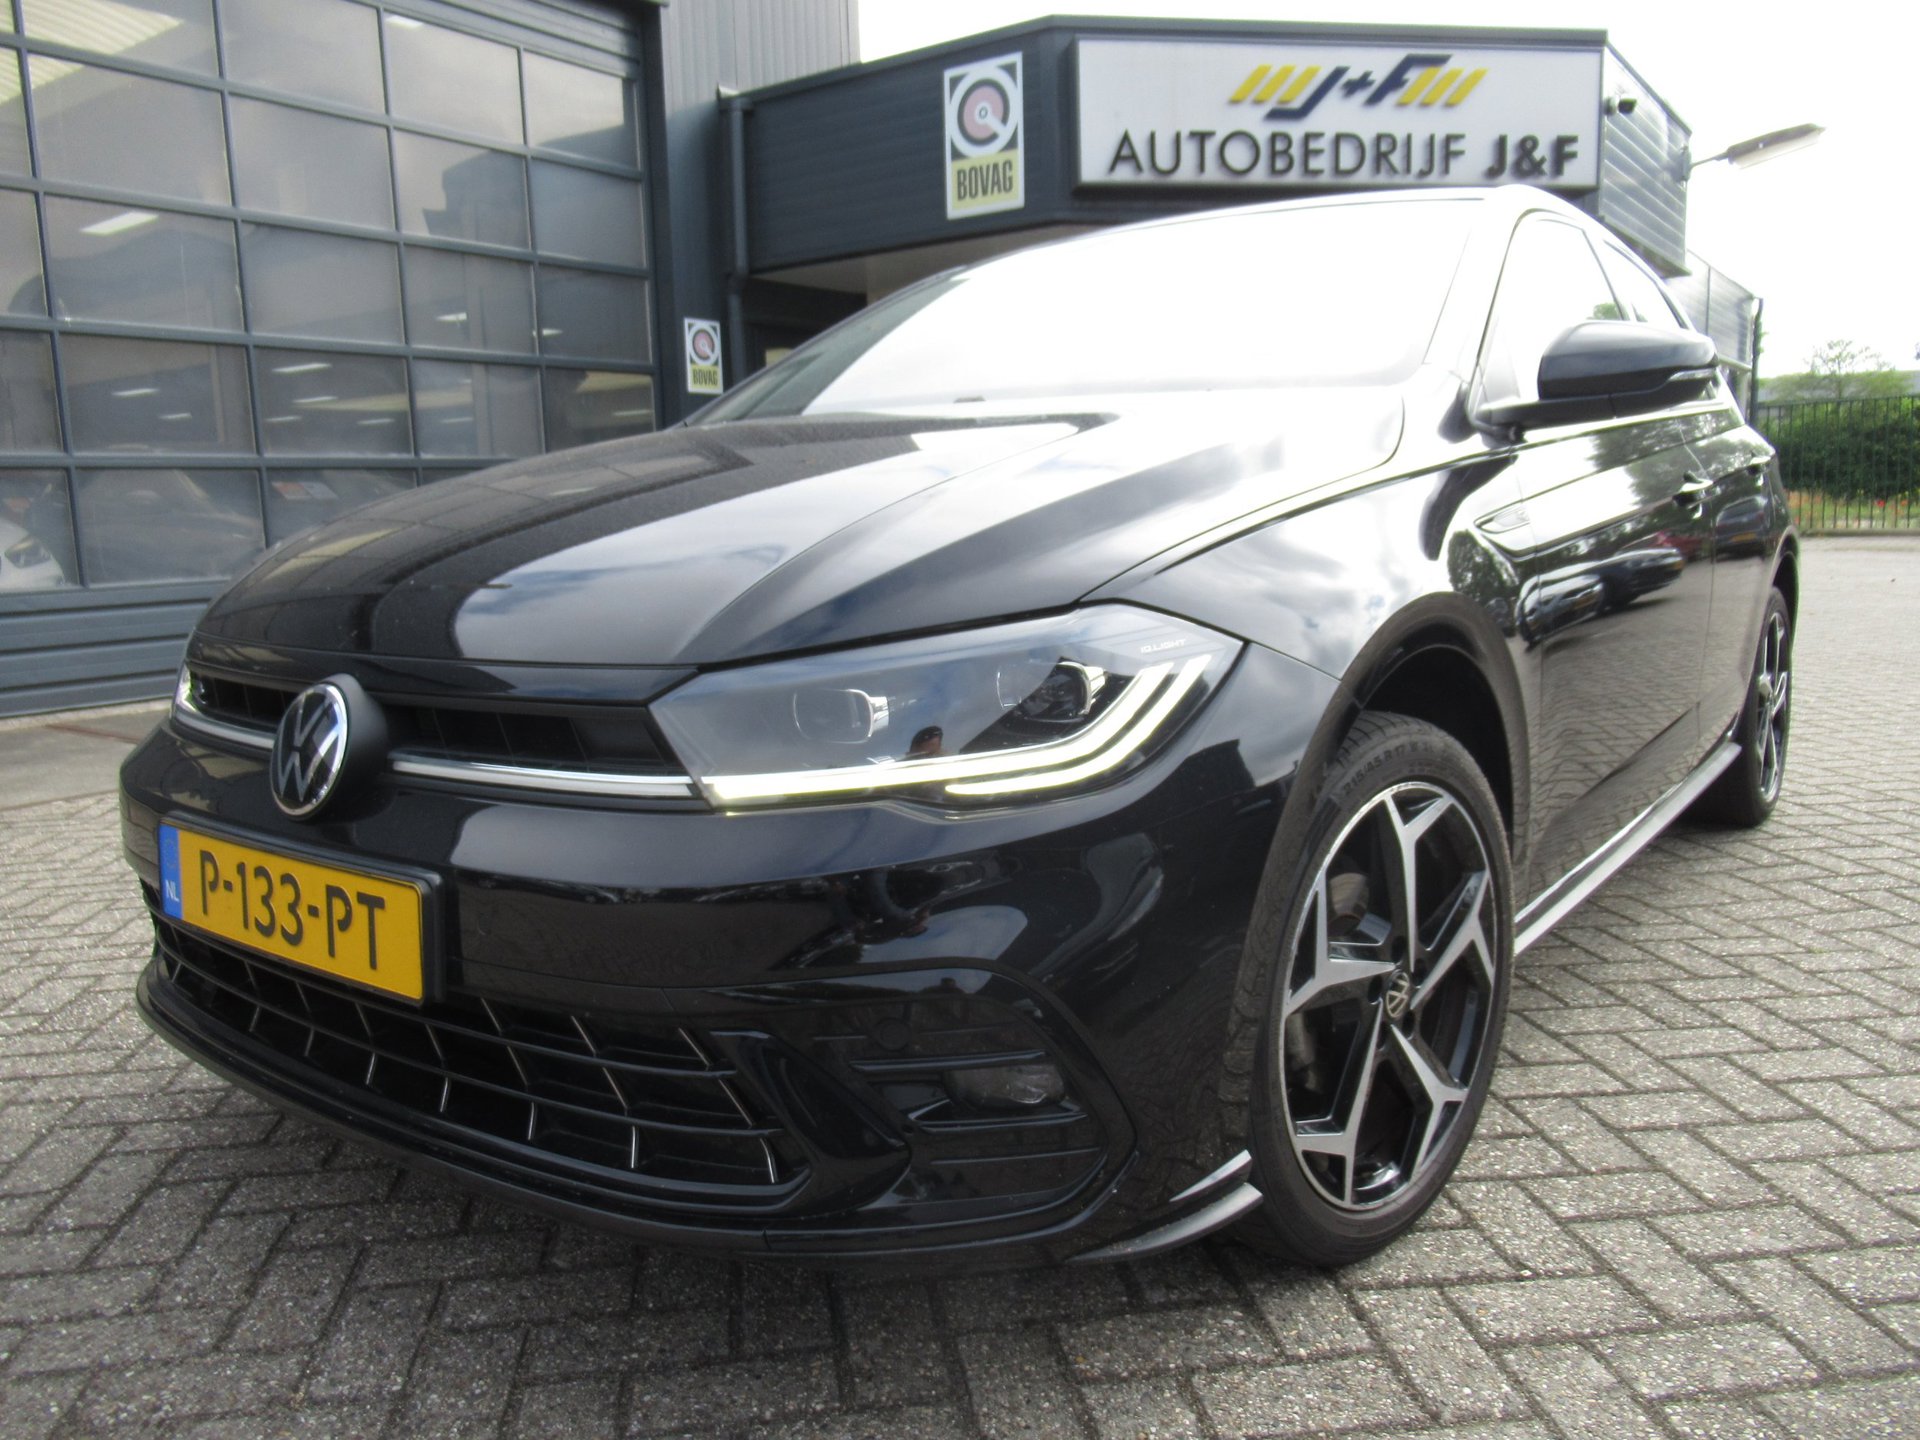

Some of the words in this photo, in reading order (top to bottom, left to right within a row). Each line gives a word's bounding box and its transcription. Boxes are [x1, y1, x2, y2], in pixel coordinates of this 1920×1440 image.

[1108, 129, 1467, 177] AUTOBEDRIJF
[1485, 133, 1580, 178] J&F
[956, 160, 1014, 201] BOVAG
[692, 369, 718, 386] BOVAG
[165, 879, 180, 903] NL
[200, 850, 386, 971] P-133-PT
